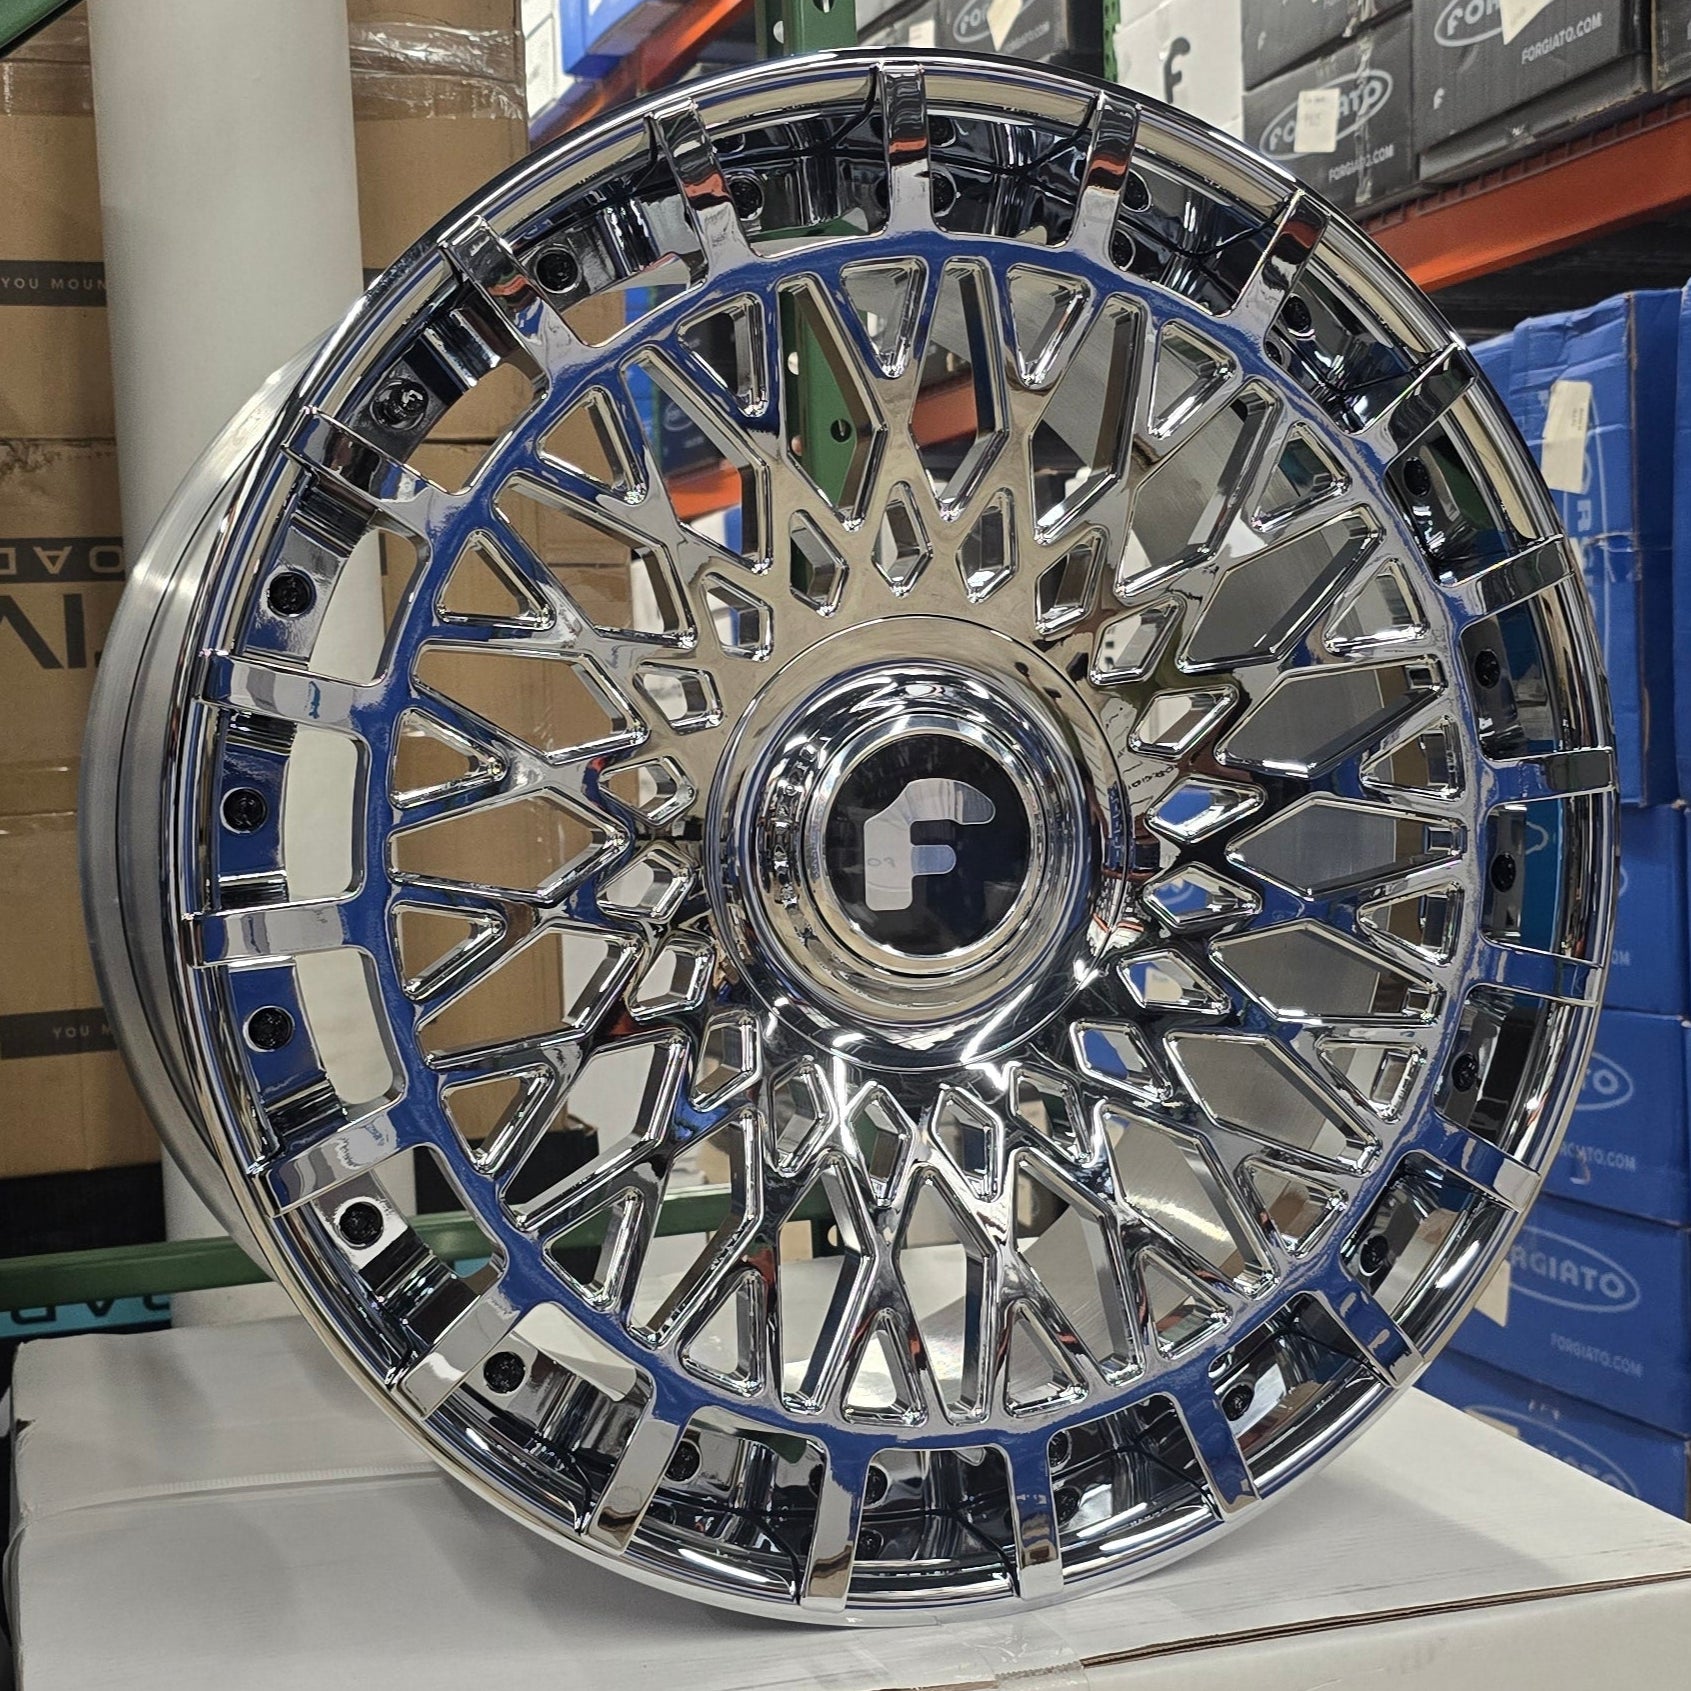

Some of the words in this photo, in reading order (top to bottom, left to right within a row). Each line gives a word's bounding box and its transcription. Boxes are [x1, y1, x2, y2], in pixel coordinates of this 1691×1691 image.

[1521, 12, 1602, 65] FORGIATO.COM
[2, 277, 39, 289] YOU
[53, 1025, 89, 1038] YOU
[1551, 1333, 1644, 1378] FORGIATO.COM
